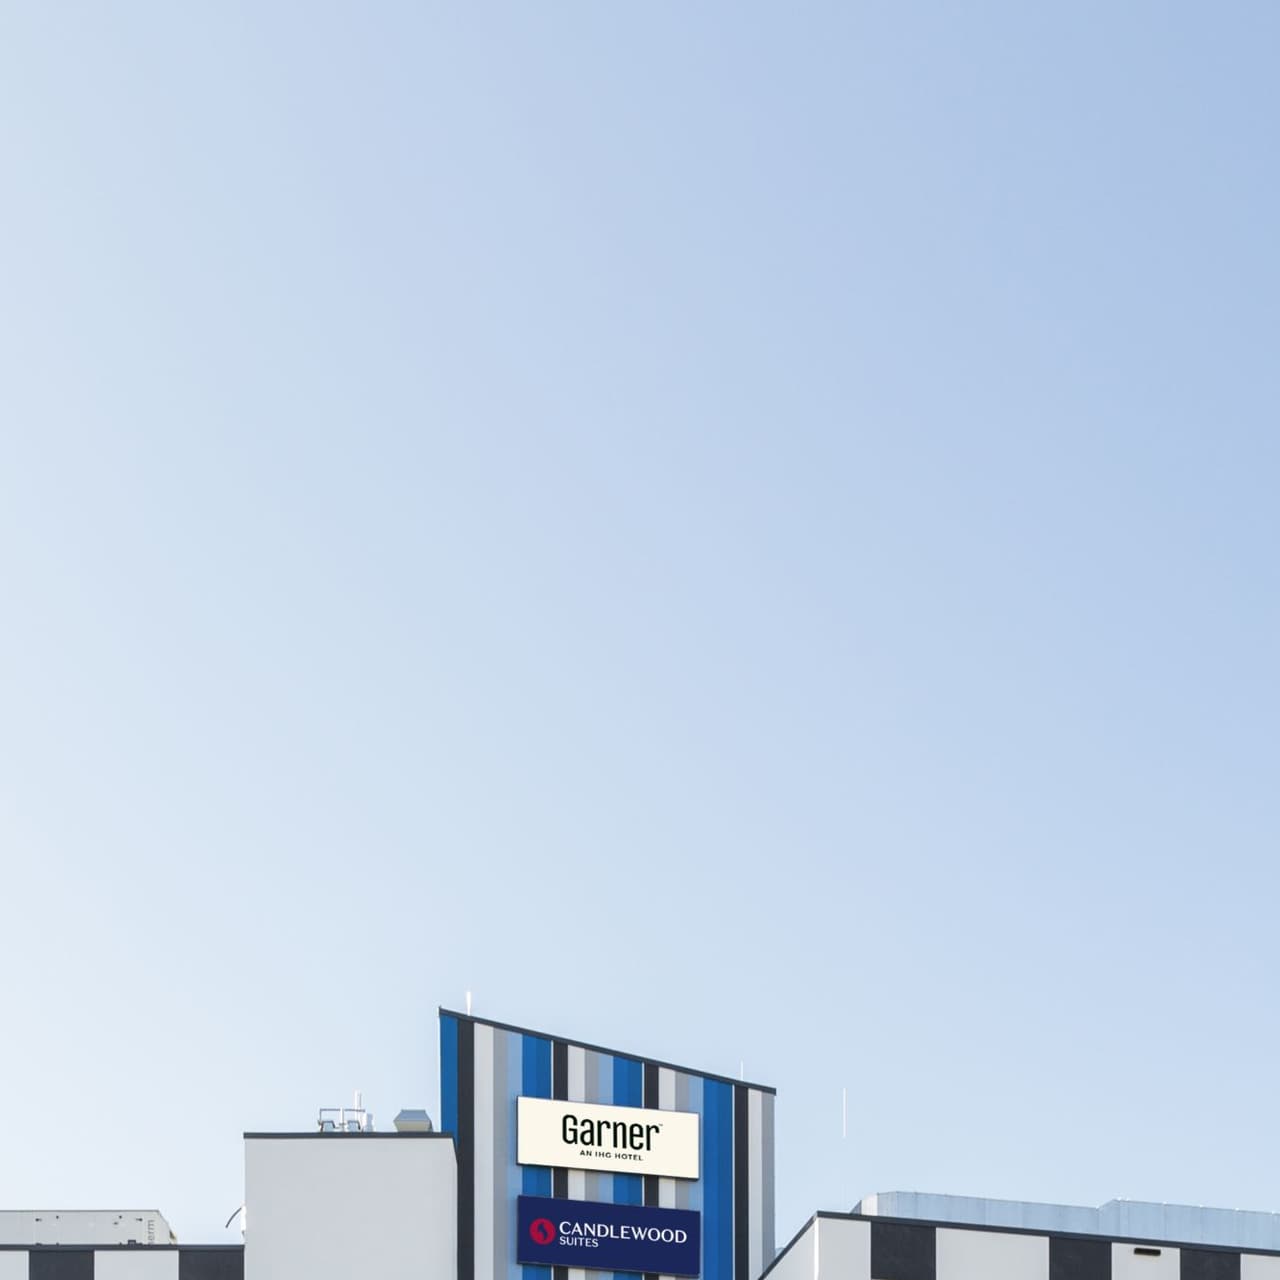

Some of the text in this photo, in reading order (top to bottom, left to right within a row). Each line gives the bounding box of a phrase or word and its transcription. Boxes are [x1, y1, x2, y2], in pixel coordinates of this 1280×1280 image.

[561, 1113, 660, 1151] Garner
[595, 1151, 612, 1159] IHG
[614, 1152, 644, 1161] HOTEL
[559, 1220, 688, 1244] CANDLEWOOD
[559, 1235, 599, 1248] SUITES
